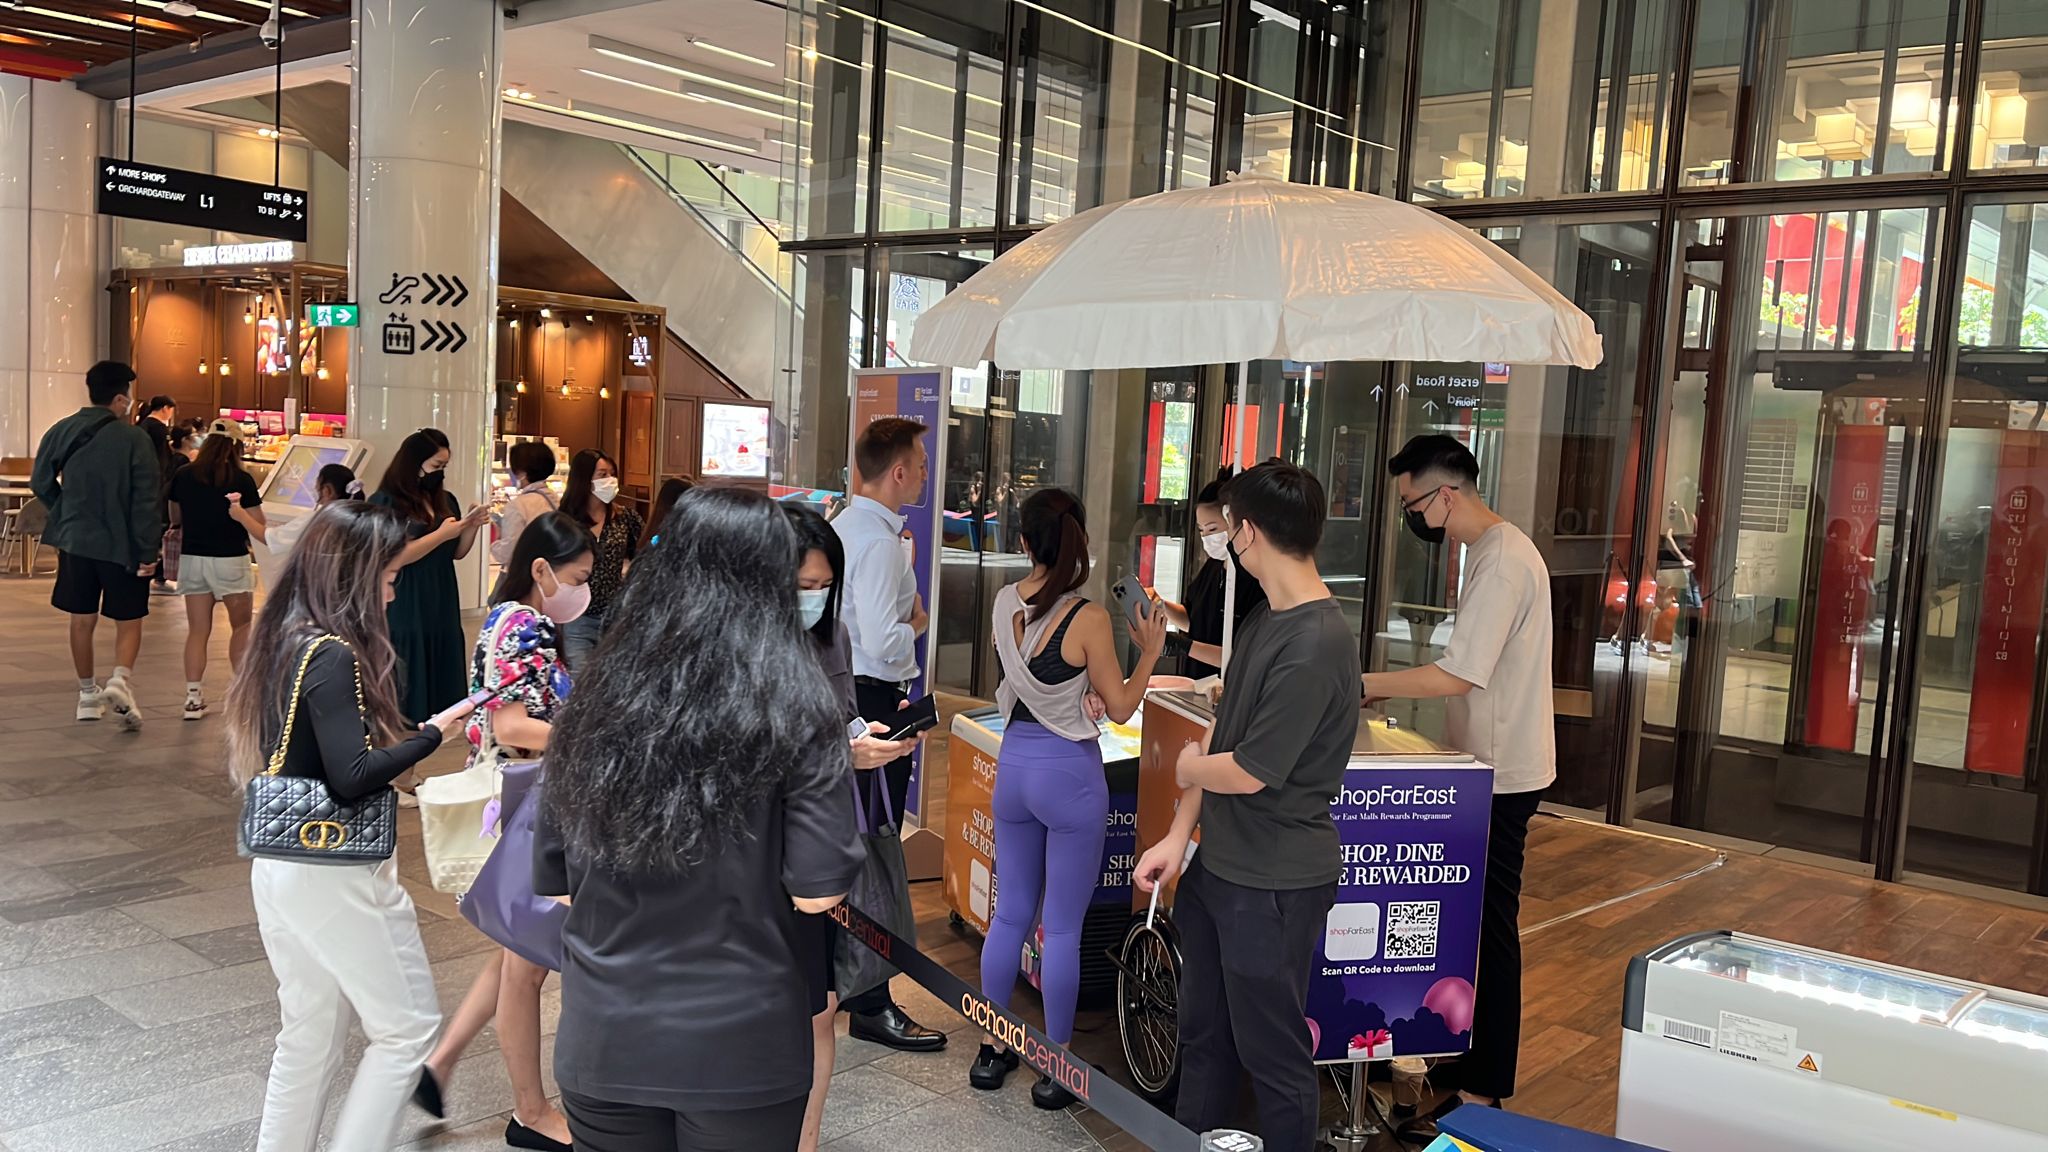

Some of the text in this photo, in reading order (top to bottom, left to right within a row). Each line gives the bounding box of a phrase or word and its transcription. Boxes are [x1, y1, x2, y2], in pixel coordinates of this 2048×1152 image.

[118, 168, 168, 184] MORE SHOPS
[118, 184, 186, 201] ORCHARDGATEWAY
[263, 192, 281, 202] LIFTS
[200, 194, 214, 208] L1
[257, 205, 277, 216] TO B1
[1343, 812, 1358, 820] East
[1360, 812, 1379, 820] Malls
[1380, 812, 1411, 820] Rewards
[1412, 811, 1452, 821] Programme
[1395, 843, 1445, 862] DINE
[1103, 872, 1123, 887] BE
[1353, 865, 1471, 886] REWARDED
[1329, 927, 1375, 937] shopFarEast
[1322, 967, 1343, 976] Scan
[1344, 966, 1357, 975] QR
[1359, 965, 1382, 974] Code
[1395, 963, 1436, 973] download
[961, 993, 1090, 1100] orchardcentral
